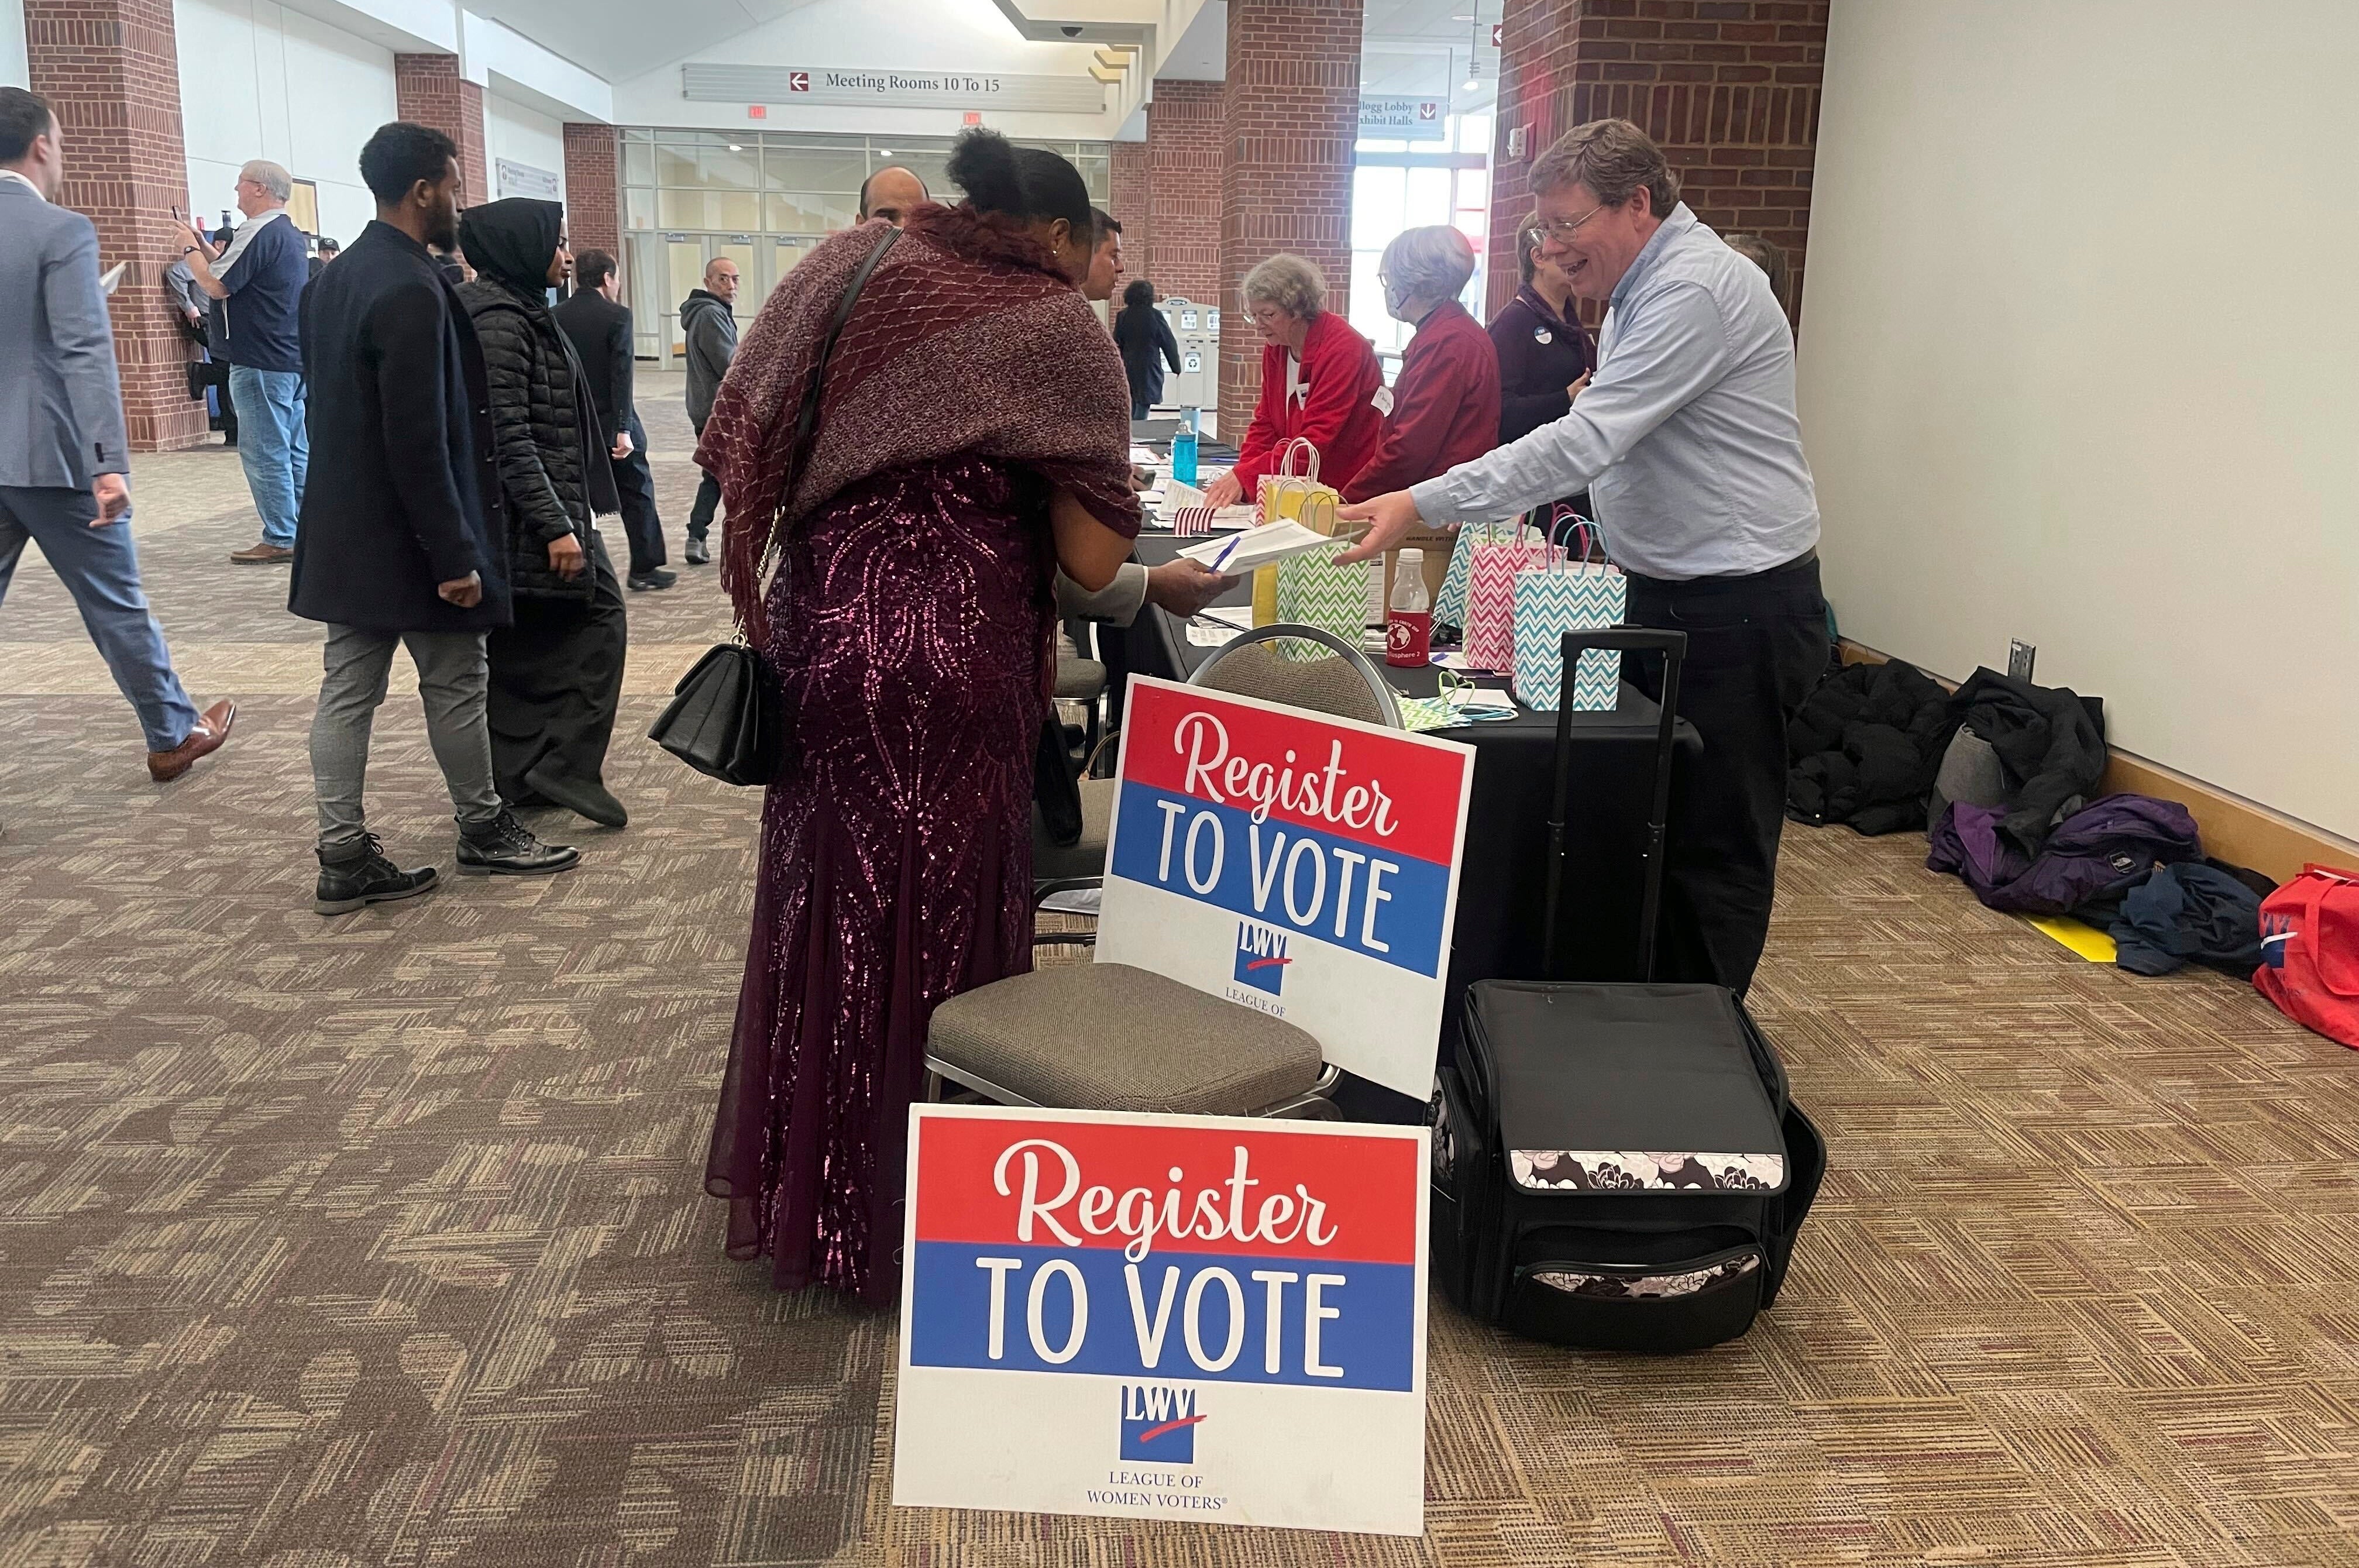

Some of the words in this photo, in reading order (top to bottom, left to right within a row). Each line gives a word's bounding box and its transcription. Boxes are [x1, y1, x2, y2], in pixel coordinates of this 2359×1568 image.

[826, 73, 885, 92] Meeting
[889, 75, 938, 90] Rooms
[944, 78, 959, 91] 10
[962, 78, 979, 91] To
[985, 79, 999, 92] 15
[1359, 101, 1382, 114] llogg
[1385, 102, 1414, 114] Lobby
[1359, 115, 1386, 125] xhibit
[1388, 116, 1413, 125] Halls
[1174, 711, 1399, 837] Register
[1157, 799, 1225, 895] TO
[1249, 824, 1399, 953] VOTE
[1239, 921, 1287, 960] LWV
[1226, 987, 1268, 1012] LEAGUE
[1271, 1003, 1287, 1017] OF
[993, 1138, 1338, 1261] Register
[975, 1257, 1088, 1364] TO
[1124, 1263, 1347, 1378] VOTE
[1125, 1385, 1195, 1422] LWV
[1109, 1471, 1175, 1487] LEAGUE
[1181, 1475, 1203, 1488] OF
[1087, 1490, 1151, 1507] WOMEN
